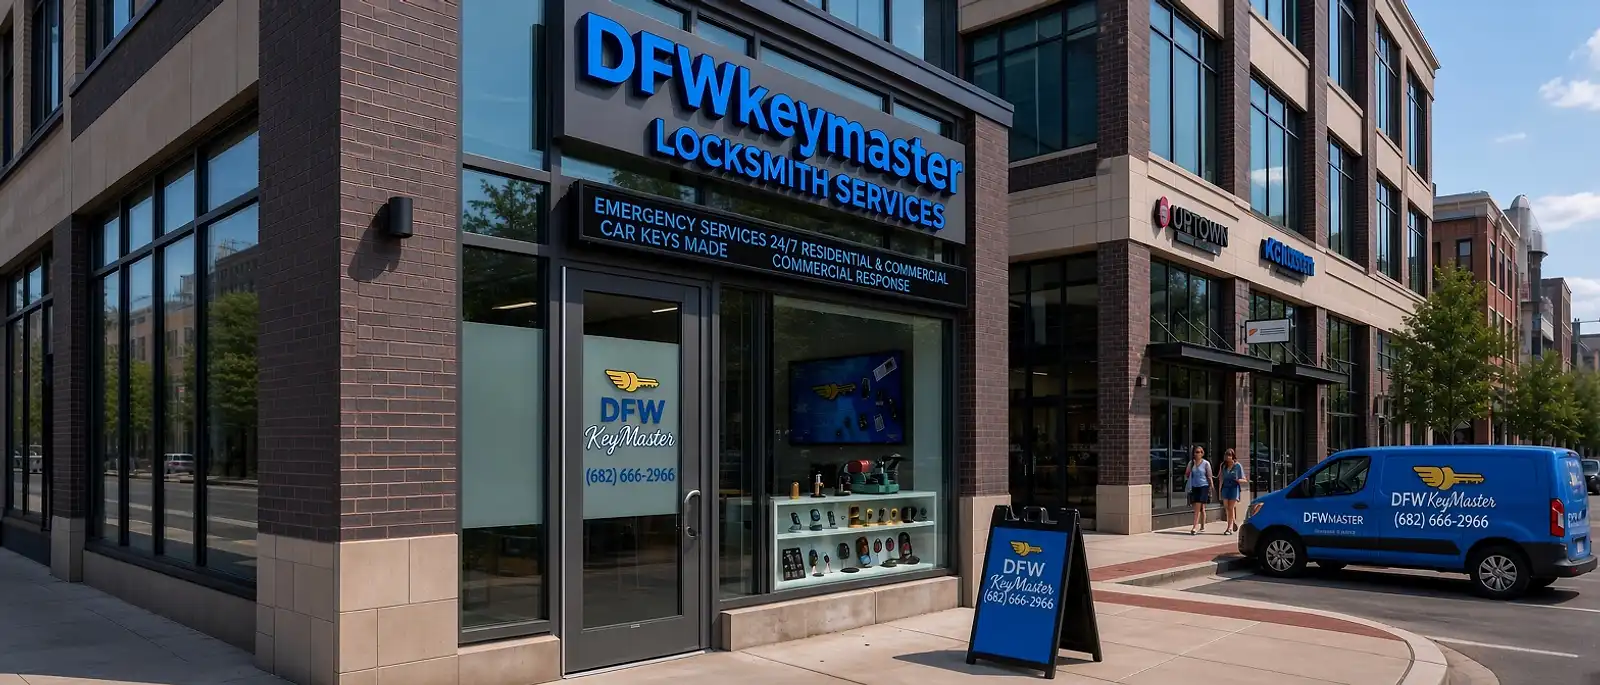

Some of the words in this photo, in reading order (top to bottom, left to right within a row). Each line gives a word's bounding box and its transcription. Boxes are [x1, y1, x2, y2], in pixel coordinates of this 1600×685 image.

[582, 12, 963, 195] DFWkeymaster
[653, 118, 828, 199] LOCKSMITH
[834, 173, 946, 231] SERVICES
[594, 197, 697, 232] EMERGENCY
[700, 220, 767, 248] SERVICES
[770, 234, 798, 254] 24/7
[801, 241, 873, 269] RESIDENTIAL
[875, 257, 883, 271] &
[884, 260, 949, 285] COMMERCIAL
[600, 220, 636, 241] CAR
[641, 227, 680, 249] KEYS
[684, 235, 728, 258] MADE
[1171, 204, 1228, 248] UPTOWN
[772, 254, 853, 282] COMMERCIAL
[856, 270, 911, 292] RESPONSE
[600, 397, 666, 425] DFW
[584, 424, 676, 456] KeyMaster
[586, 467, 617, 486] (682)
[620, 467, 675, 482] 666-2966
[1391, 491, 1427, 507] DFW
[1427, 491, 1497, 513] KeyMaster
[1394, 511, 1425, 529] (682)
[1428, 513, 1489, 528] 666-2966
[1003, 558, 1046, 577] DFW
[983, 589, 1007, 606] (682)
[1008, 593, 1054, 610] 666-2966
[990, 574, 1054, 596] KeyMaster
